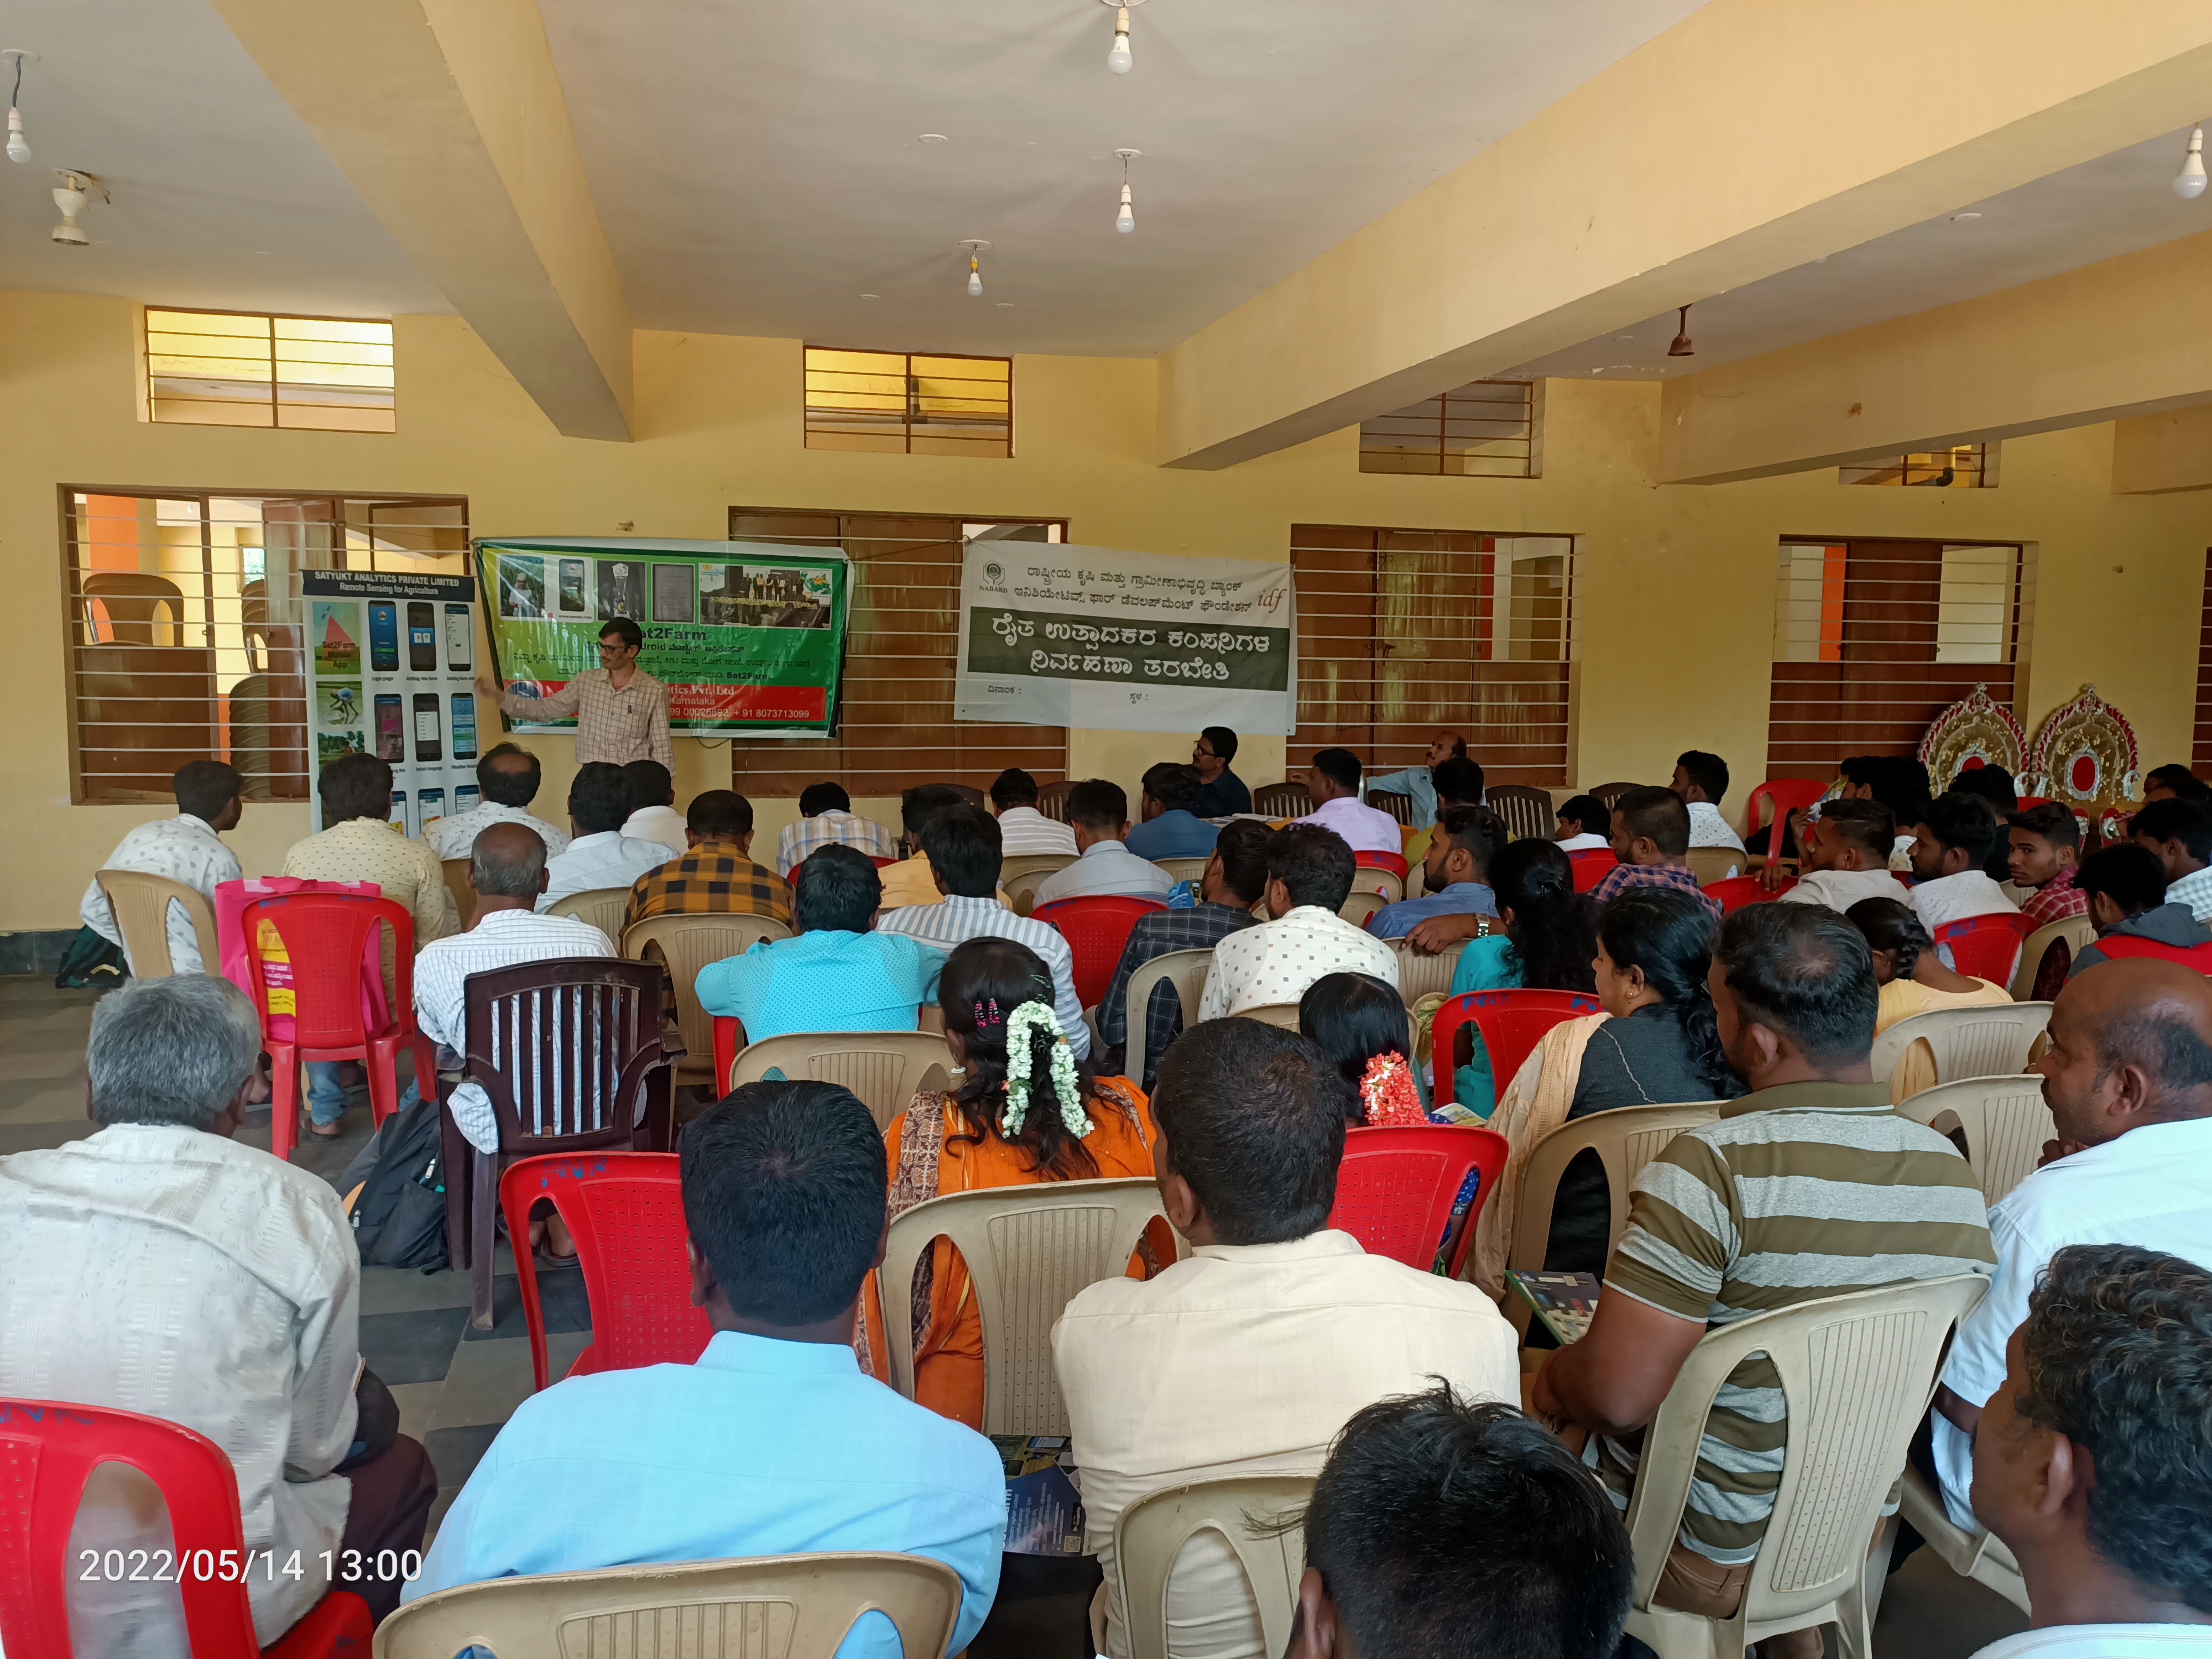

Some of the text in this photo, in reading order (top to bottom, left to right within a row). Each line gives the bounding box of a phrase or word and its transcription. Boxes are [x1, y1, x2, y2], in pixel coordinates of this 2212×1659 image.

[315, 571, 460, 587] SATYUKT ANALYTICS PRIVATE LIMITED
[1027, 567, 1071, 585] ರಾಷ್ಟ್ರೀಯ
[1077, 569, 1094, 586] ಕೃಷಿ
[1100, 572, 1126, 588] ಮತ್ತು
[1211, 581, 1243, 597] ಬ್ಯಾಂಕ್
[340, 582, 439, 595] Remote Sensing for Agriculture
[979, 585, 1008, 593] NABARD
[1089, 593, 1116, 604] ಫಾರ್
[1258, 588, 1287, 614] idf
[641, 627, 706, 640] at2Farm
[993, 612, 1270, 654] ರೈತ ಉತ್ಪಾದಕರ ಕಂಪನಿಗಳ
[332, 661, 348, 669] App
[681, 658, 700, 667] ಮತ್ತು
[1030, 649, 1230, 681] ನಿರ್ವಹಣಾ ತರಬೇತಿ
[716, 686, 735, 696] Ltd
[743, 709, 753, 717] 91
[755, 709, 810, 718] 8073713099
